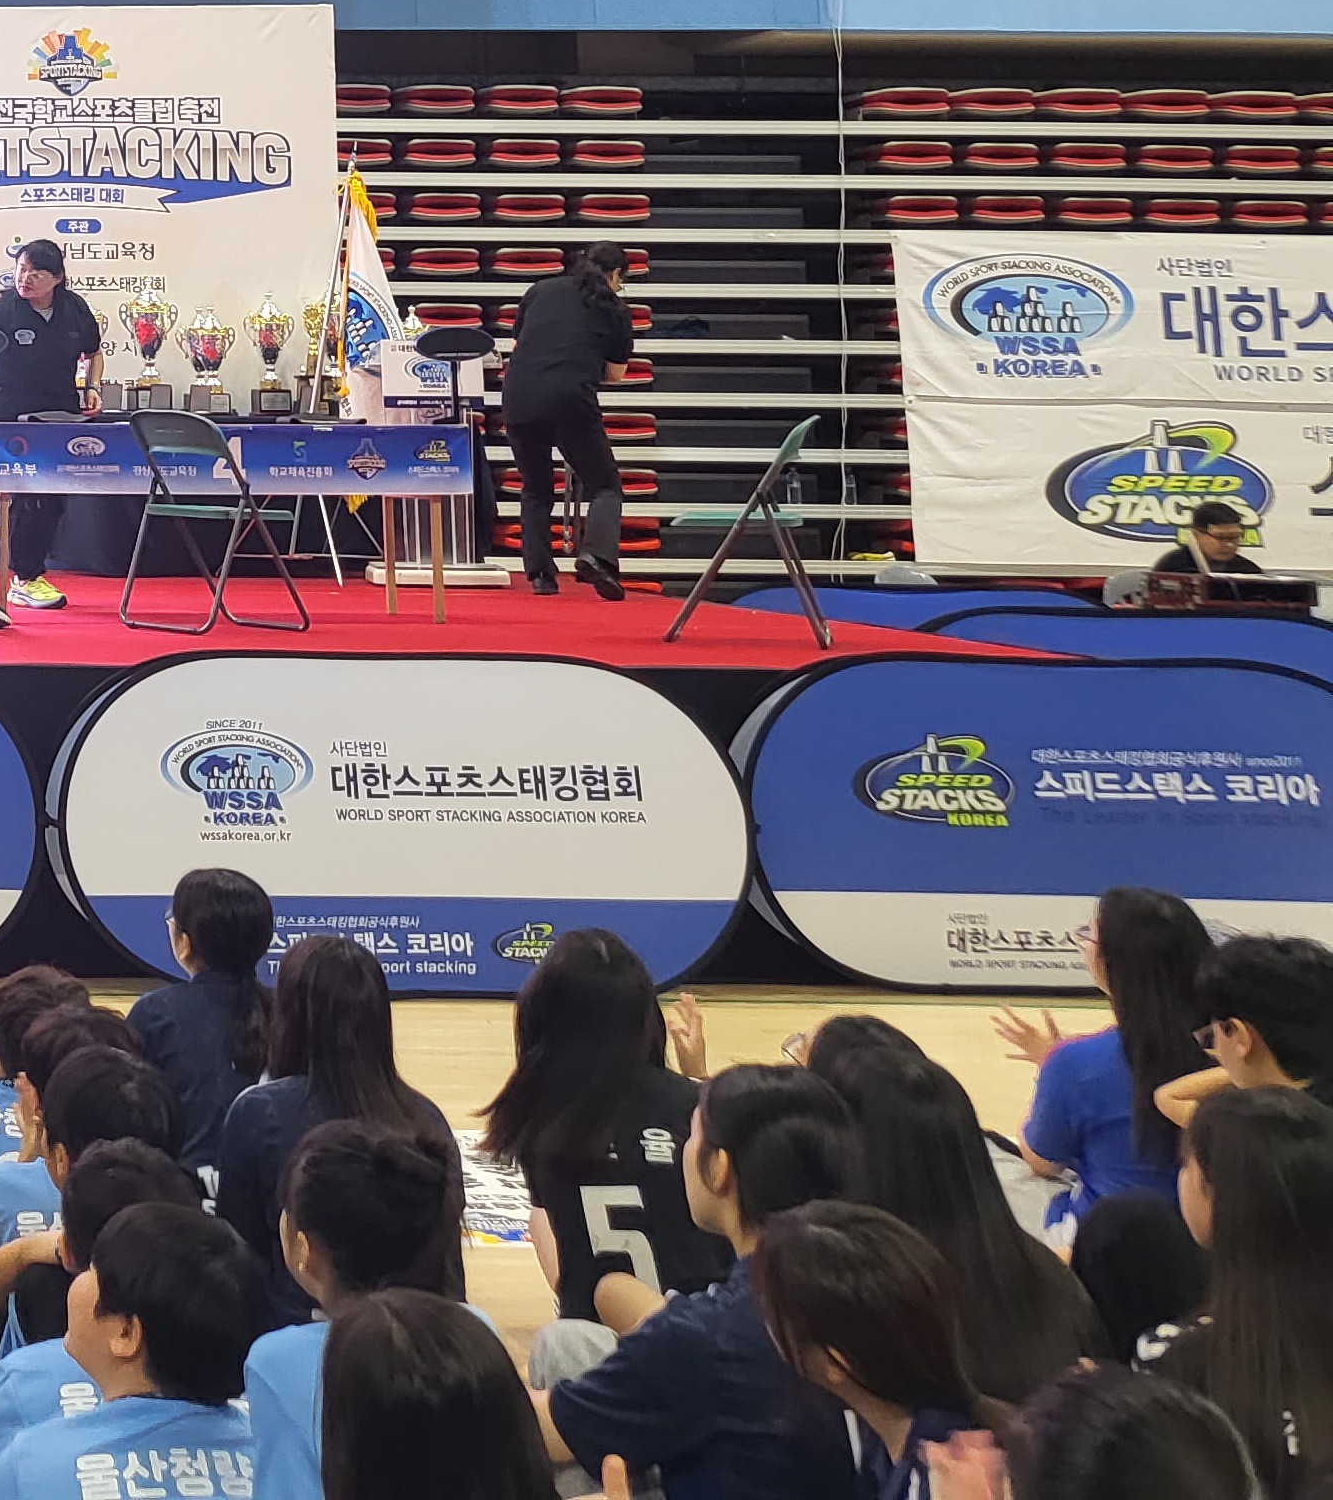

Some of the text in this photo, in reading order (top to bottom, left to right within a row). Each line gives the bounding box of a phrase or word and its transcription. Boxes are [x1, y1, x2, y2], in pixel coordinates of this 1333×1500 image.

[177, 98, 221, 124] 축전
[20, 186, 125, 205] 스포츠스태킹 대회
[67, 220, 90, 234] 주관
[62, 241, 155, 261] 남도교육청
[1157, 257, 1234, 278] 사단법인
[937, 271, 970, 299] WORLD
[969, 262, 999, 278] SPORT
[1001, 260, 1052, 271] STACKING
[993, 335, 1081, 357] WSSA
[993, 358, 1089, 378] KOREA
[1213, 364, 1304, 384] WORLD
[212, 435, 248, 487] 4
[1106, 475, 1244, 494] SPEED
[1077, 494, 1262, 527] STACS
[205, 719, 263, 730] SINCE 2011
[329, 740, 388, 758] 사단법인
[329, 762, 644, 803] 대한스포츠스태킹협회
[894, 774, 993, 787] SPEED
[1034, 769, 1321, 808] 스피드스택스 코리아
[202, 790, 284, 811] WSSA
[875, 788, 1007, 812] STACKS
[213, 811, 278, 827] KOREA
[335, 807, 647, 825] WORLD SPORT STACKING ASSOCIATION KOREA
[947, 813, 1010, 828] KOREA
[200, 829, 292, 842] wssakorea.or.kr
[273, 915, 420, 928] 한스포츠스태킹협회공식후원사
[406, 931, 474, 957] 코리아
[415, 960, 477, 976] stacking
